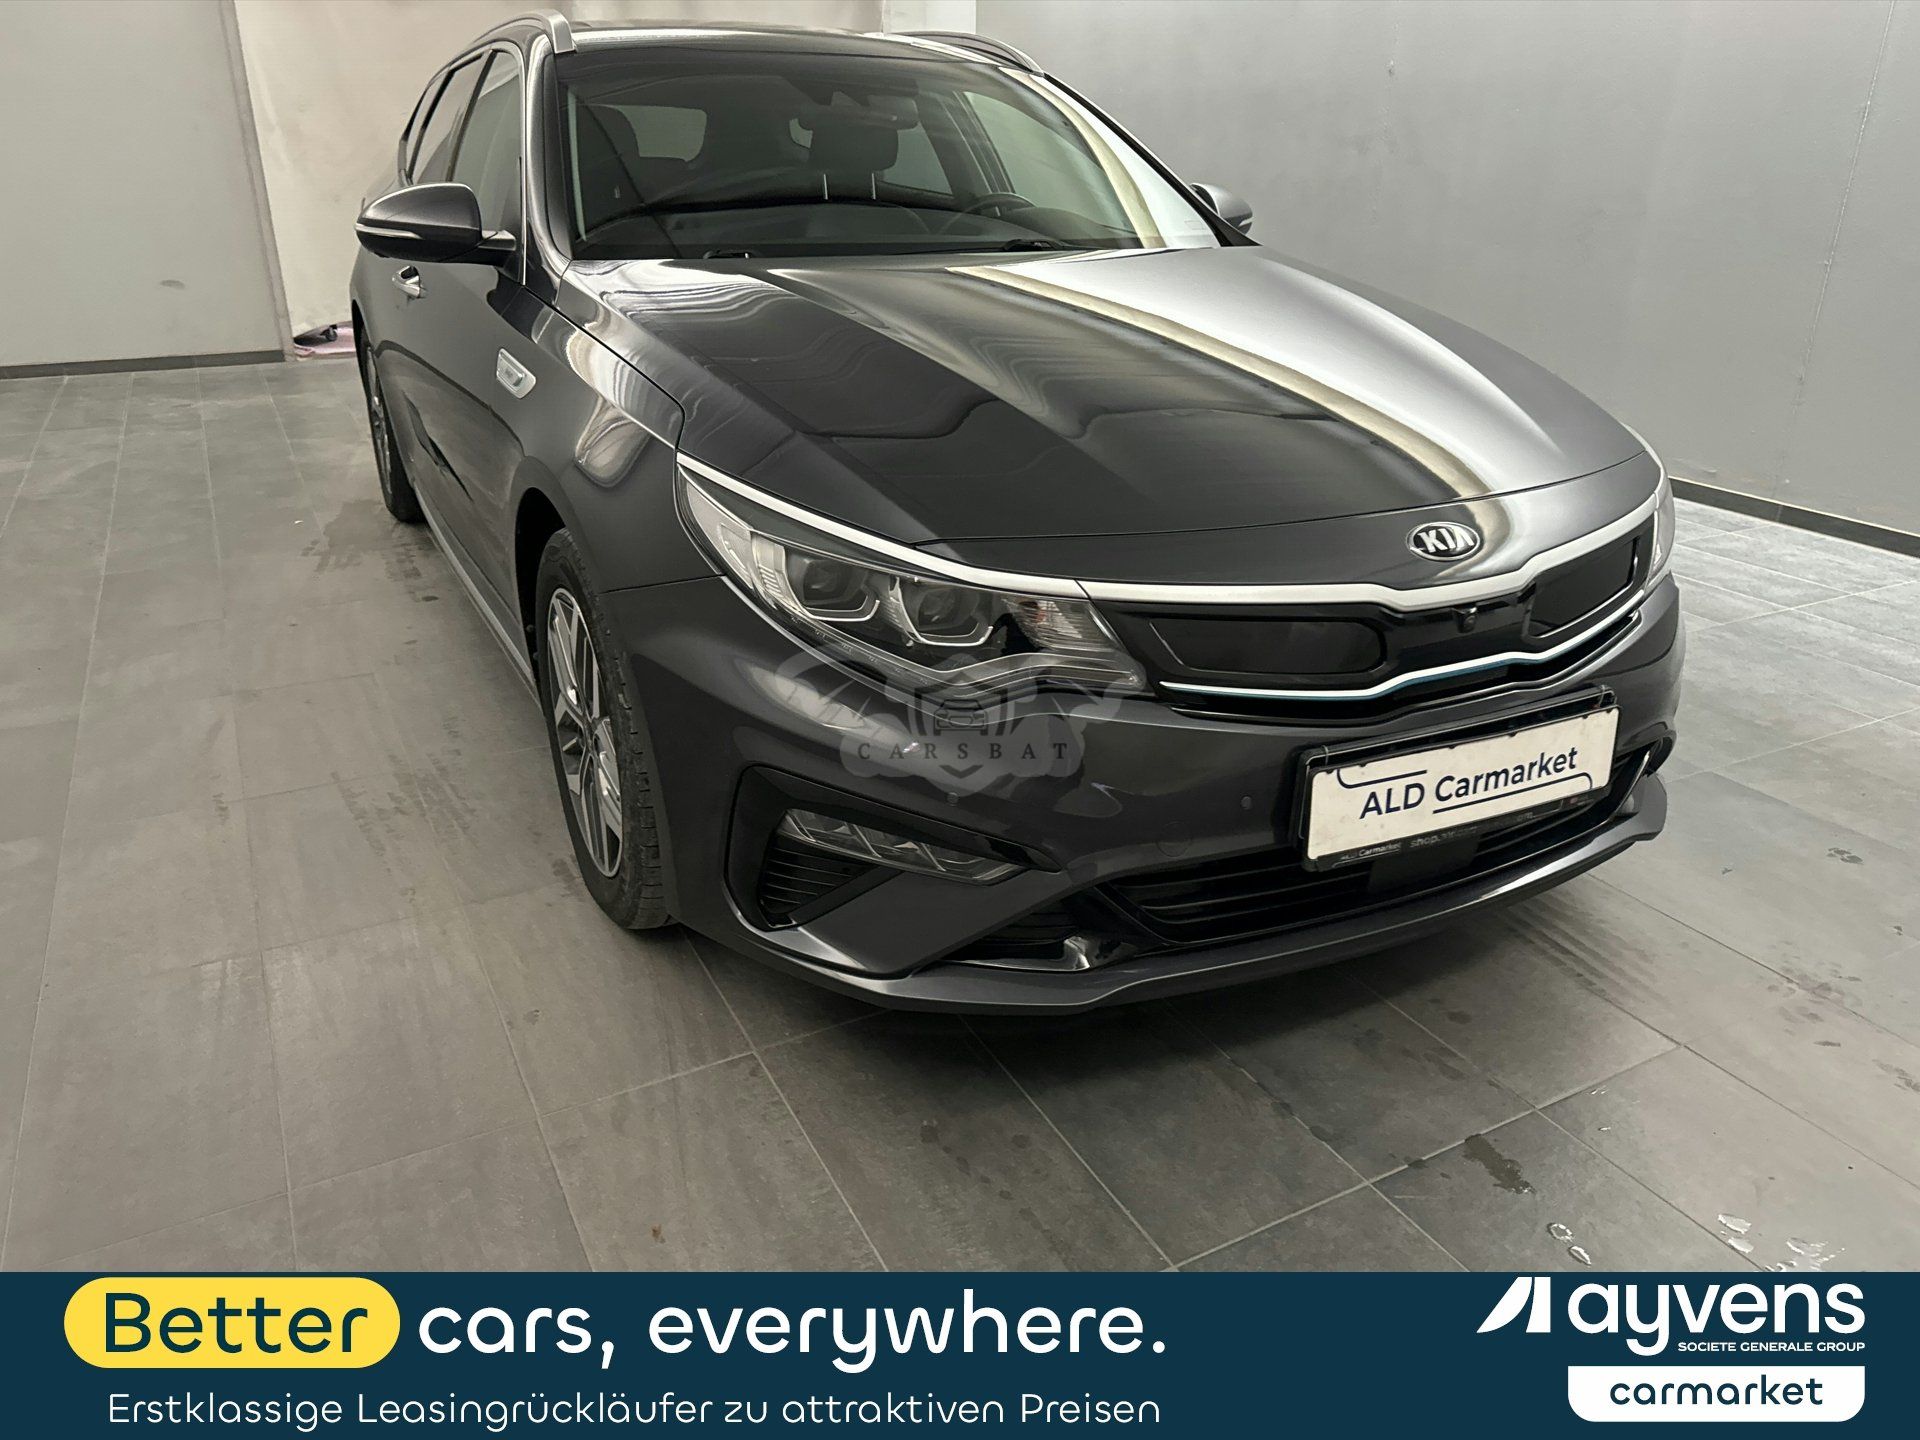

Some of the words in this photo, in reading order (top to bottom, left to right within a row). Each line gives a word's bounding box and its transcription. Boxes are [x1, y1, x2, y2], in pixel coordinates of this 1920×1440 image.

[1417, 525, 1475, 553] KIA
[1359, 782, 1426, 819] ALD
[1434, 747, 1578, 802] Carmarket
